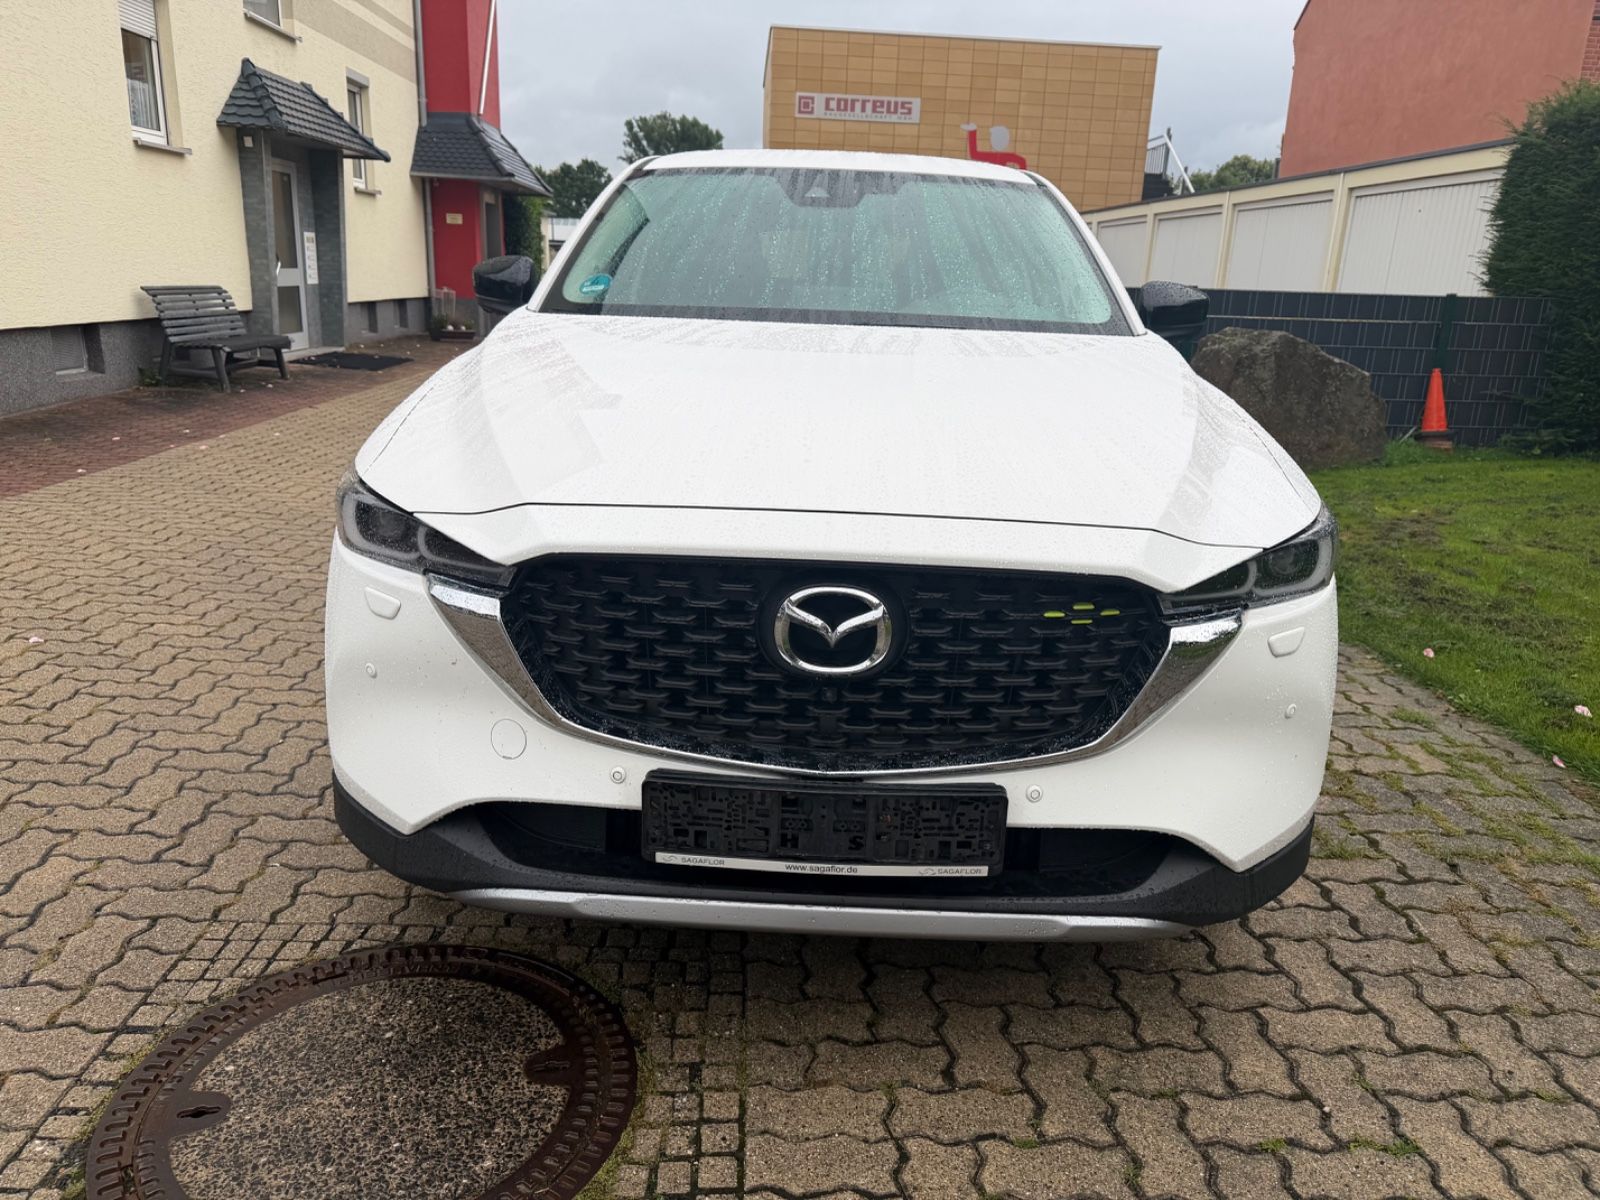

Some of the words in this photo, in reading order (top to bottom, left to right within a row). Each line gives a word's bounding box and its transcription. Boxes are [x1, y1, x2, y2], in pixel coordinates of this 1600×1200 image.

[824, 97, 913, 115] correus
[681, 857, 725, 866] SAGAFLOR
[785, 864, 858, 875] www.sagaflor.de
